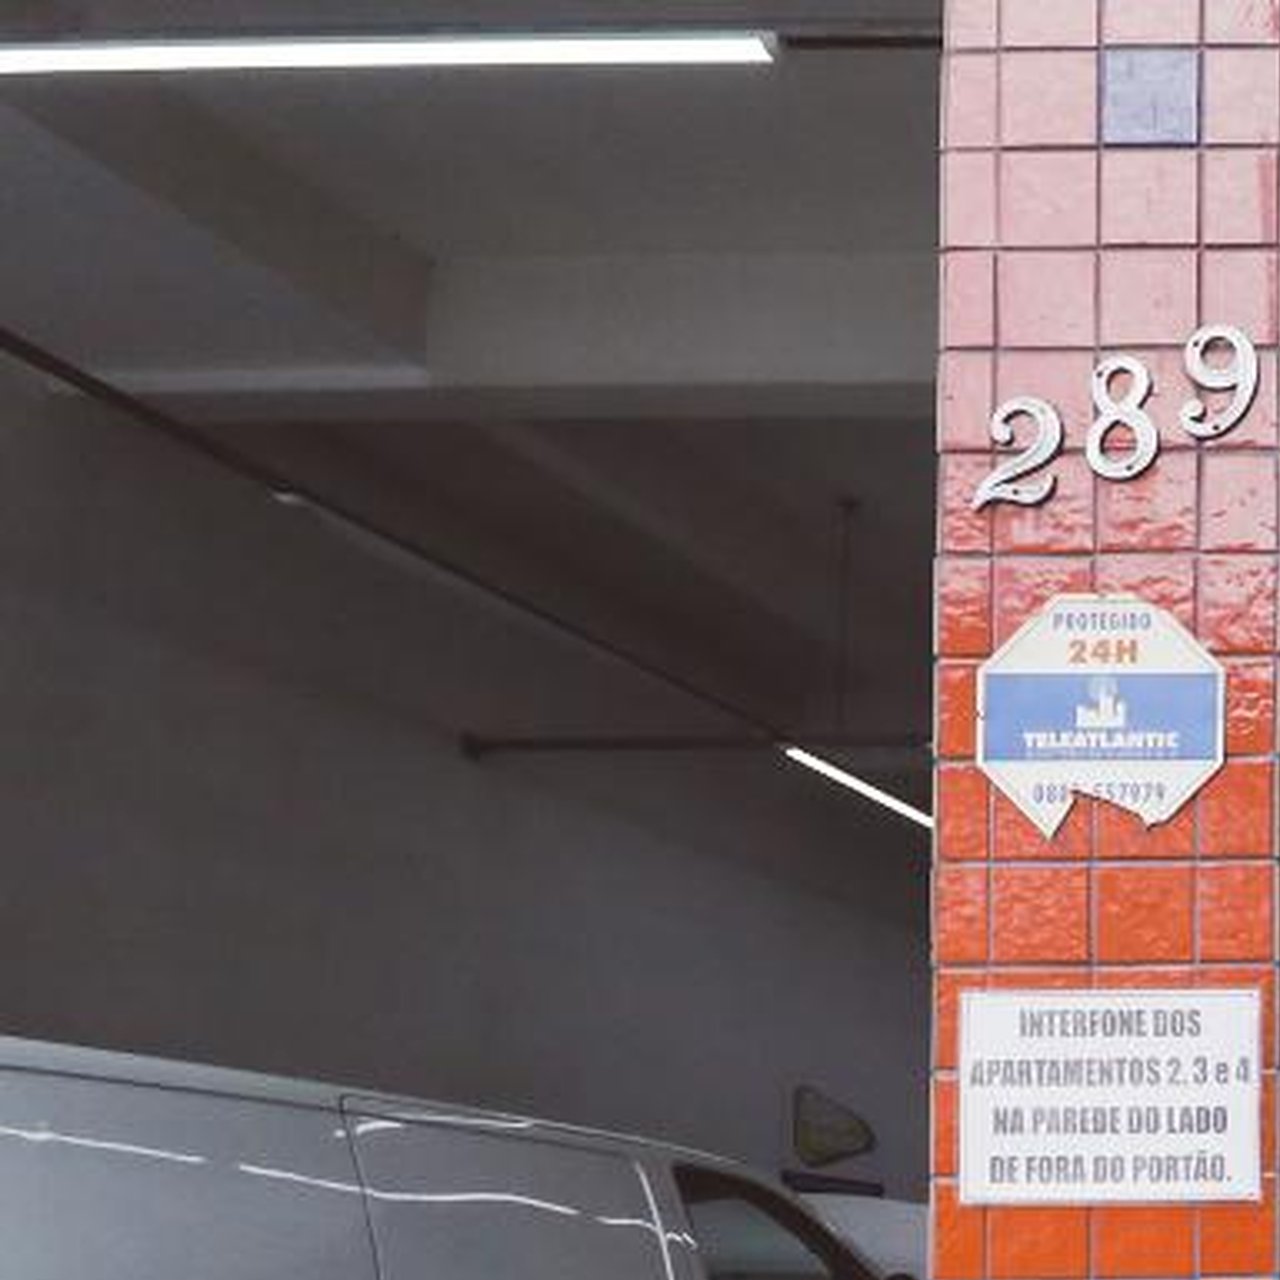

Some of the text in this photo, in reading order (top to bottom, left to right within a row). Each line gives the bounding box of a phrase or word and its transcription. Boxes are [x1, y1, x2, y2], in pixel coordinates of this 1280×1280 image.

[970, 323, 1260, 511] 289
[1052, 612, 1152, 631] PROTEGIDO
[1068, 639, 1139, 664] 24H
[1023, 731, 1180, 749] TELEATLANTIC
[1019, 1008, 1202, 1038] INTERFONE DOS
[970, 1058, 1162, 1088] APARTAMENTOS
[1193, 1056, 1208, 1084] 3
[1215, 1062, 1228, 1084] e
[1236, 1057, 1250, 1083] 4
[993, 1106, 1229, 1135] NA PAREDE DO LADO
[989, 1150, 1232, 1184] DE FORA DO PORTÃO.
